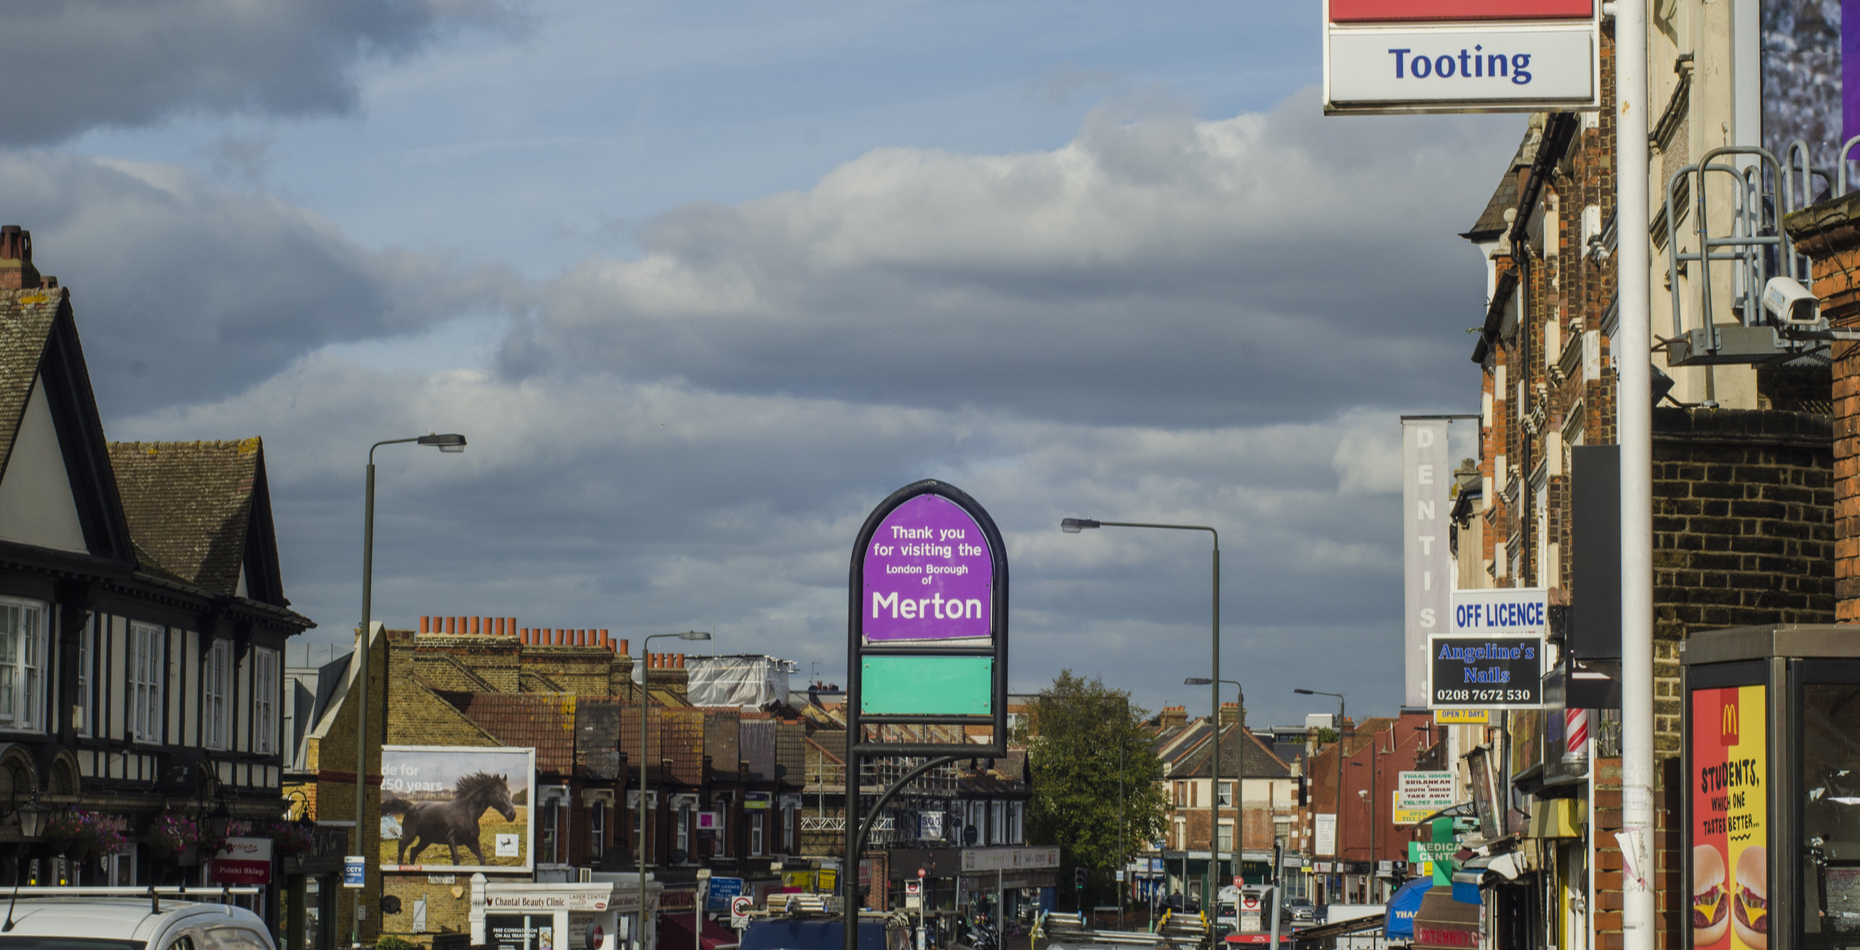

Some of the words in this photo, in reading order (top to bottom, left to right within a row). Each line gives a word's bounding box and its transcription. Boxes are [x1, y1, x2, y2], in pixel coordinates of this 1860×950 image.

[1388, 44, 1532, 85] Tooting
[891, 526, 933, 539] Thank
[940, 528, 965, 541] you
[873, 543, 894, 556] for
[901, 543, 952, 558] visiting
[958, 543, 982, 556] the
[886, 564, 922, 574] London
[926, 564, 968, 575] Borough
[921, 575, 933, 585] of
[872, 592, 982, 619] Merton
[1456, 604, 1482, 628] OFF
[1486, 602, 1544, 627] LICENCE
[1438, 643, 1535, 663] Angeline's
[1464, 666, 1510, 683] Nails
[1437, 689, 1469, 700] 0208
[1472, 689, 1504, 700] 7672
[1506, 689, 1531, 700] 530
[1441, 710, 1459, 718] OPEN
[1462, 710, 1466, 718] 7
[1468, 710, 1485, 718] DAYS
[381, 764, 397, 776] de
[400, 763, 420, 776] for
[1701, 758, 1760, 794] STUDENTS,
[381, 778, 404, 790] 250
[406, 780, 443, 793] years
[1711, 795, 1731, 812] WHICH
[1733, 791, 1745, 809] ONE
[1703, 818, 1727, 836] TASTES
[1416, 843, 1462, 851] MEDICA
[1419, 852, 1453, 861] CENT
[219, 866, 242, 874] Polski
[243, 867, 265, 876] Sklep
[495, 897, 520, 906] Chantal
[522, 897, 545, 908] Beauty
[546, 897, 565, 906] Clinic
[1419, 928, 1468, 946] INTERNET
